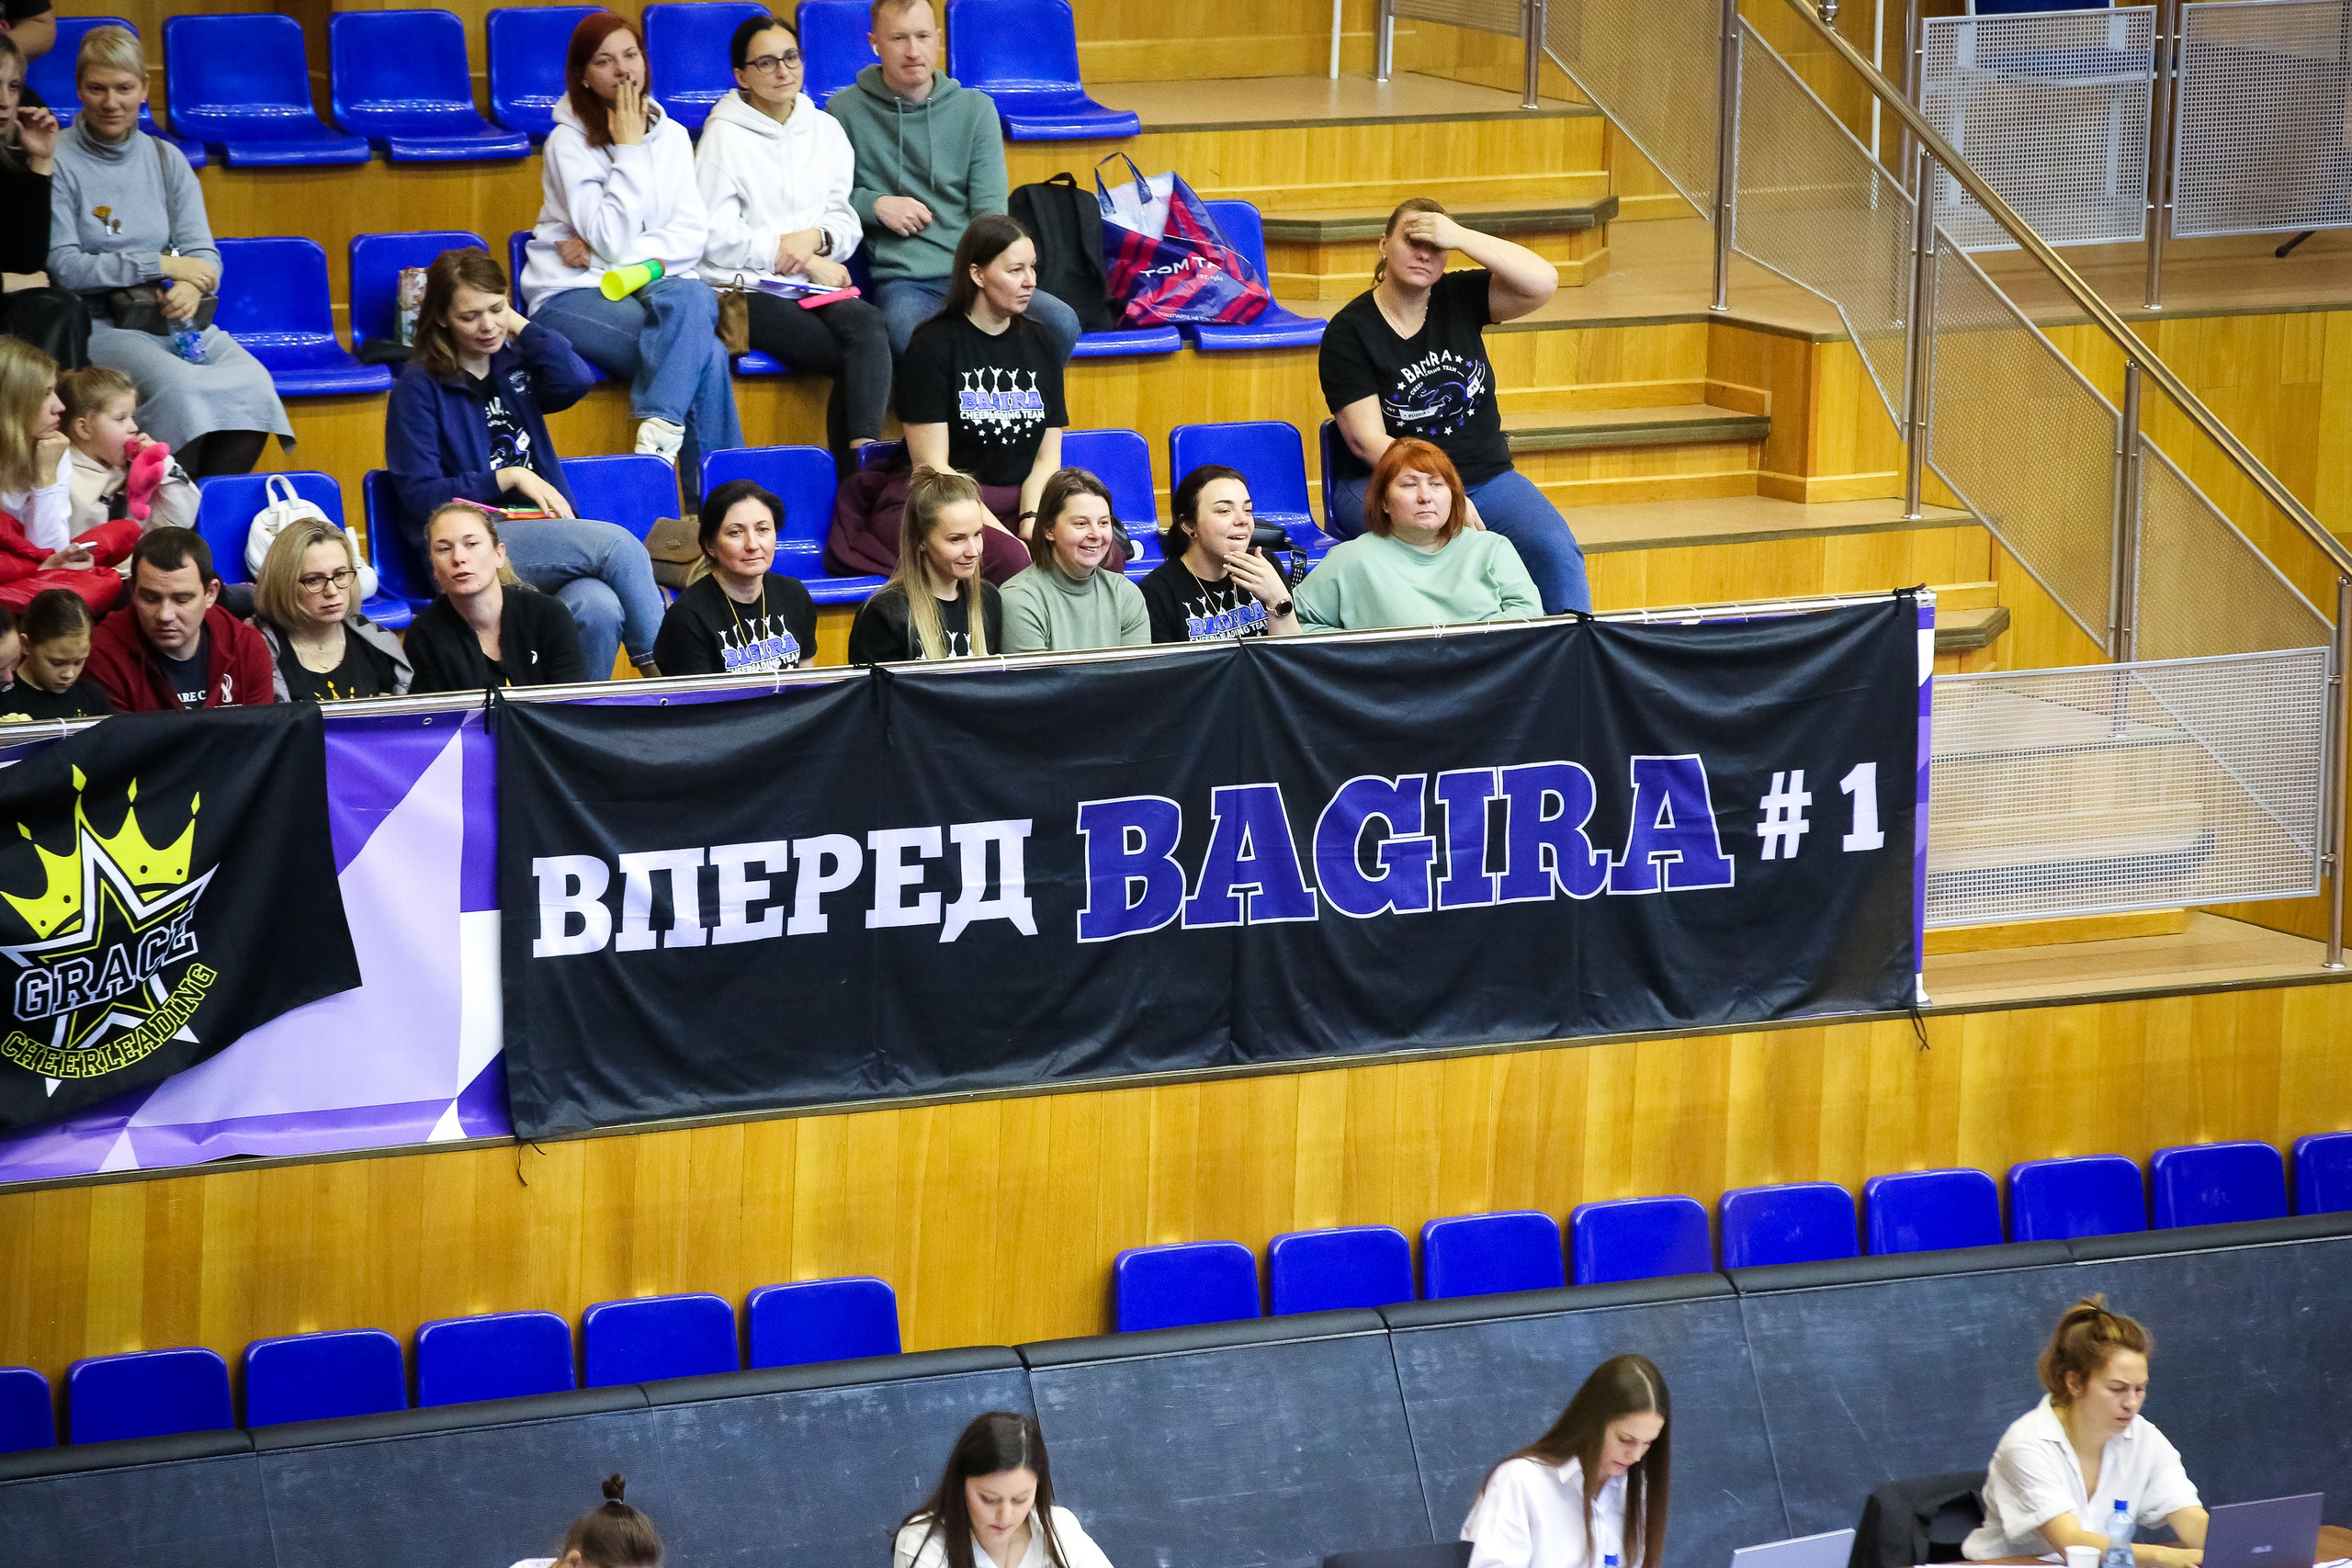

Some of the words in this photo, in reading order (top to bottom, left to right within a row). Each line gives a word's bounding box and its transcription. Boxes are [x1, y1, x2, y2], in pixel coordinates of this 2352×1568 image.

[1139, 257, 1191, 277] TOM
[1022, 410, 1046, 420] TEAM
[532, 818, 1038, 958] ВПЕРЕД
[1077, 754, 1735, 943] BAGIRA
[1, 963, 218, 1078] CHEERLEADING
[14, 905, 198, 1021] GRACE
